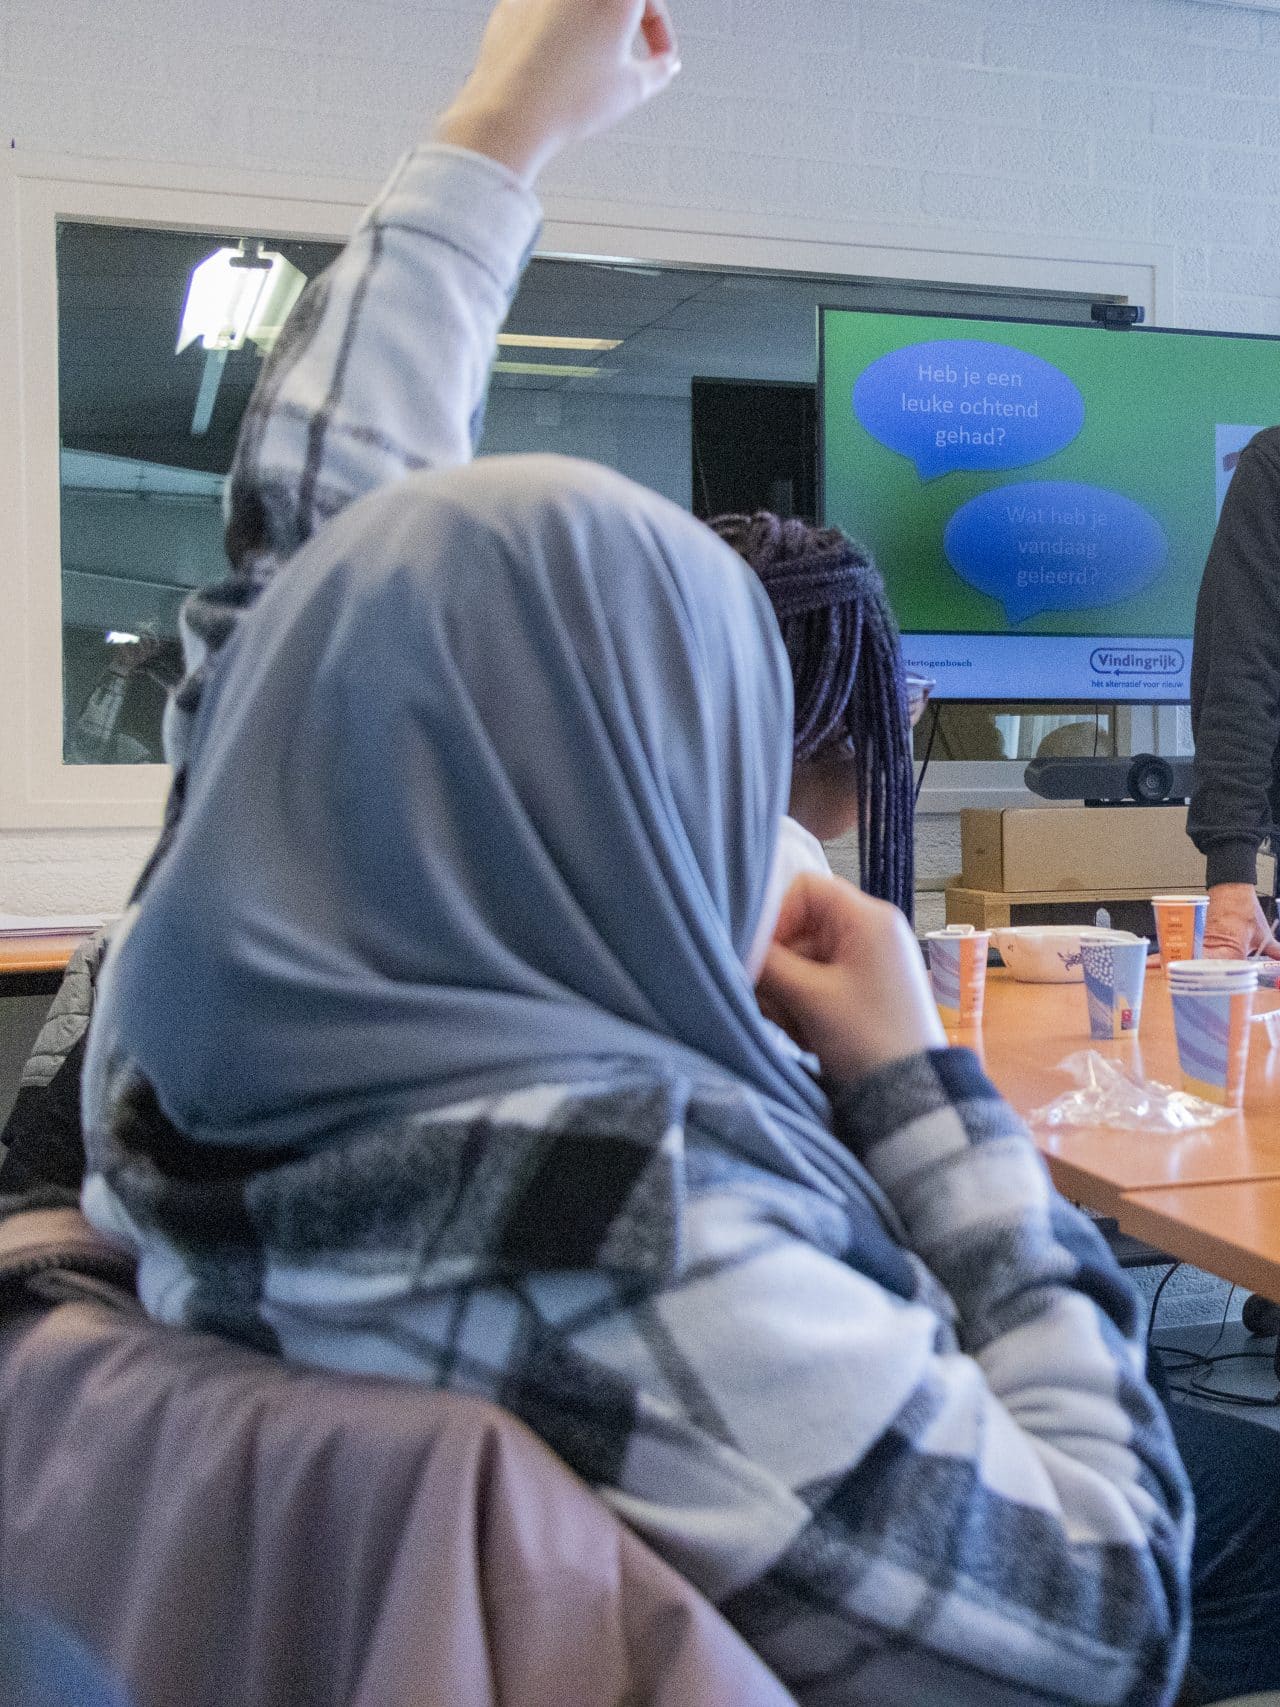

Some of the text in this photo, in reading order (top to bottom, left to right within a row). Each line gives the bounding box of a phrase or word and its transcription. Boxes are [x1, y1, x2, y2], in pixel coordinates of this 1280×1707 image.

[918, 364, 1023, 388] Heb je een
[901, 392, 1038, 418] leuke ochtend
[935, 425, 1006, 448] gehad?
[1006, 506, 1108, 534] Wat heb je
[1018, 539, 1098, 559] vandaag
[1017, 566, 1099, 588] geleerd?
[1098, 654, 1177, 670] Vindingrijk
[1105, 680, 1141, 688] alternatief
